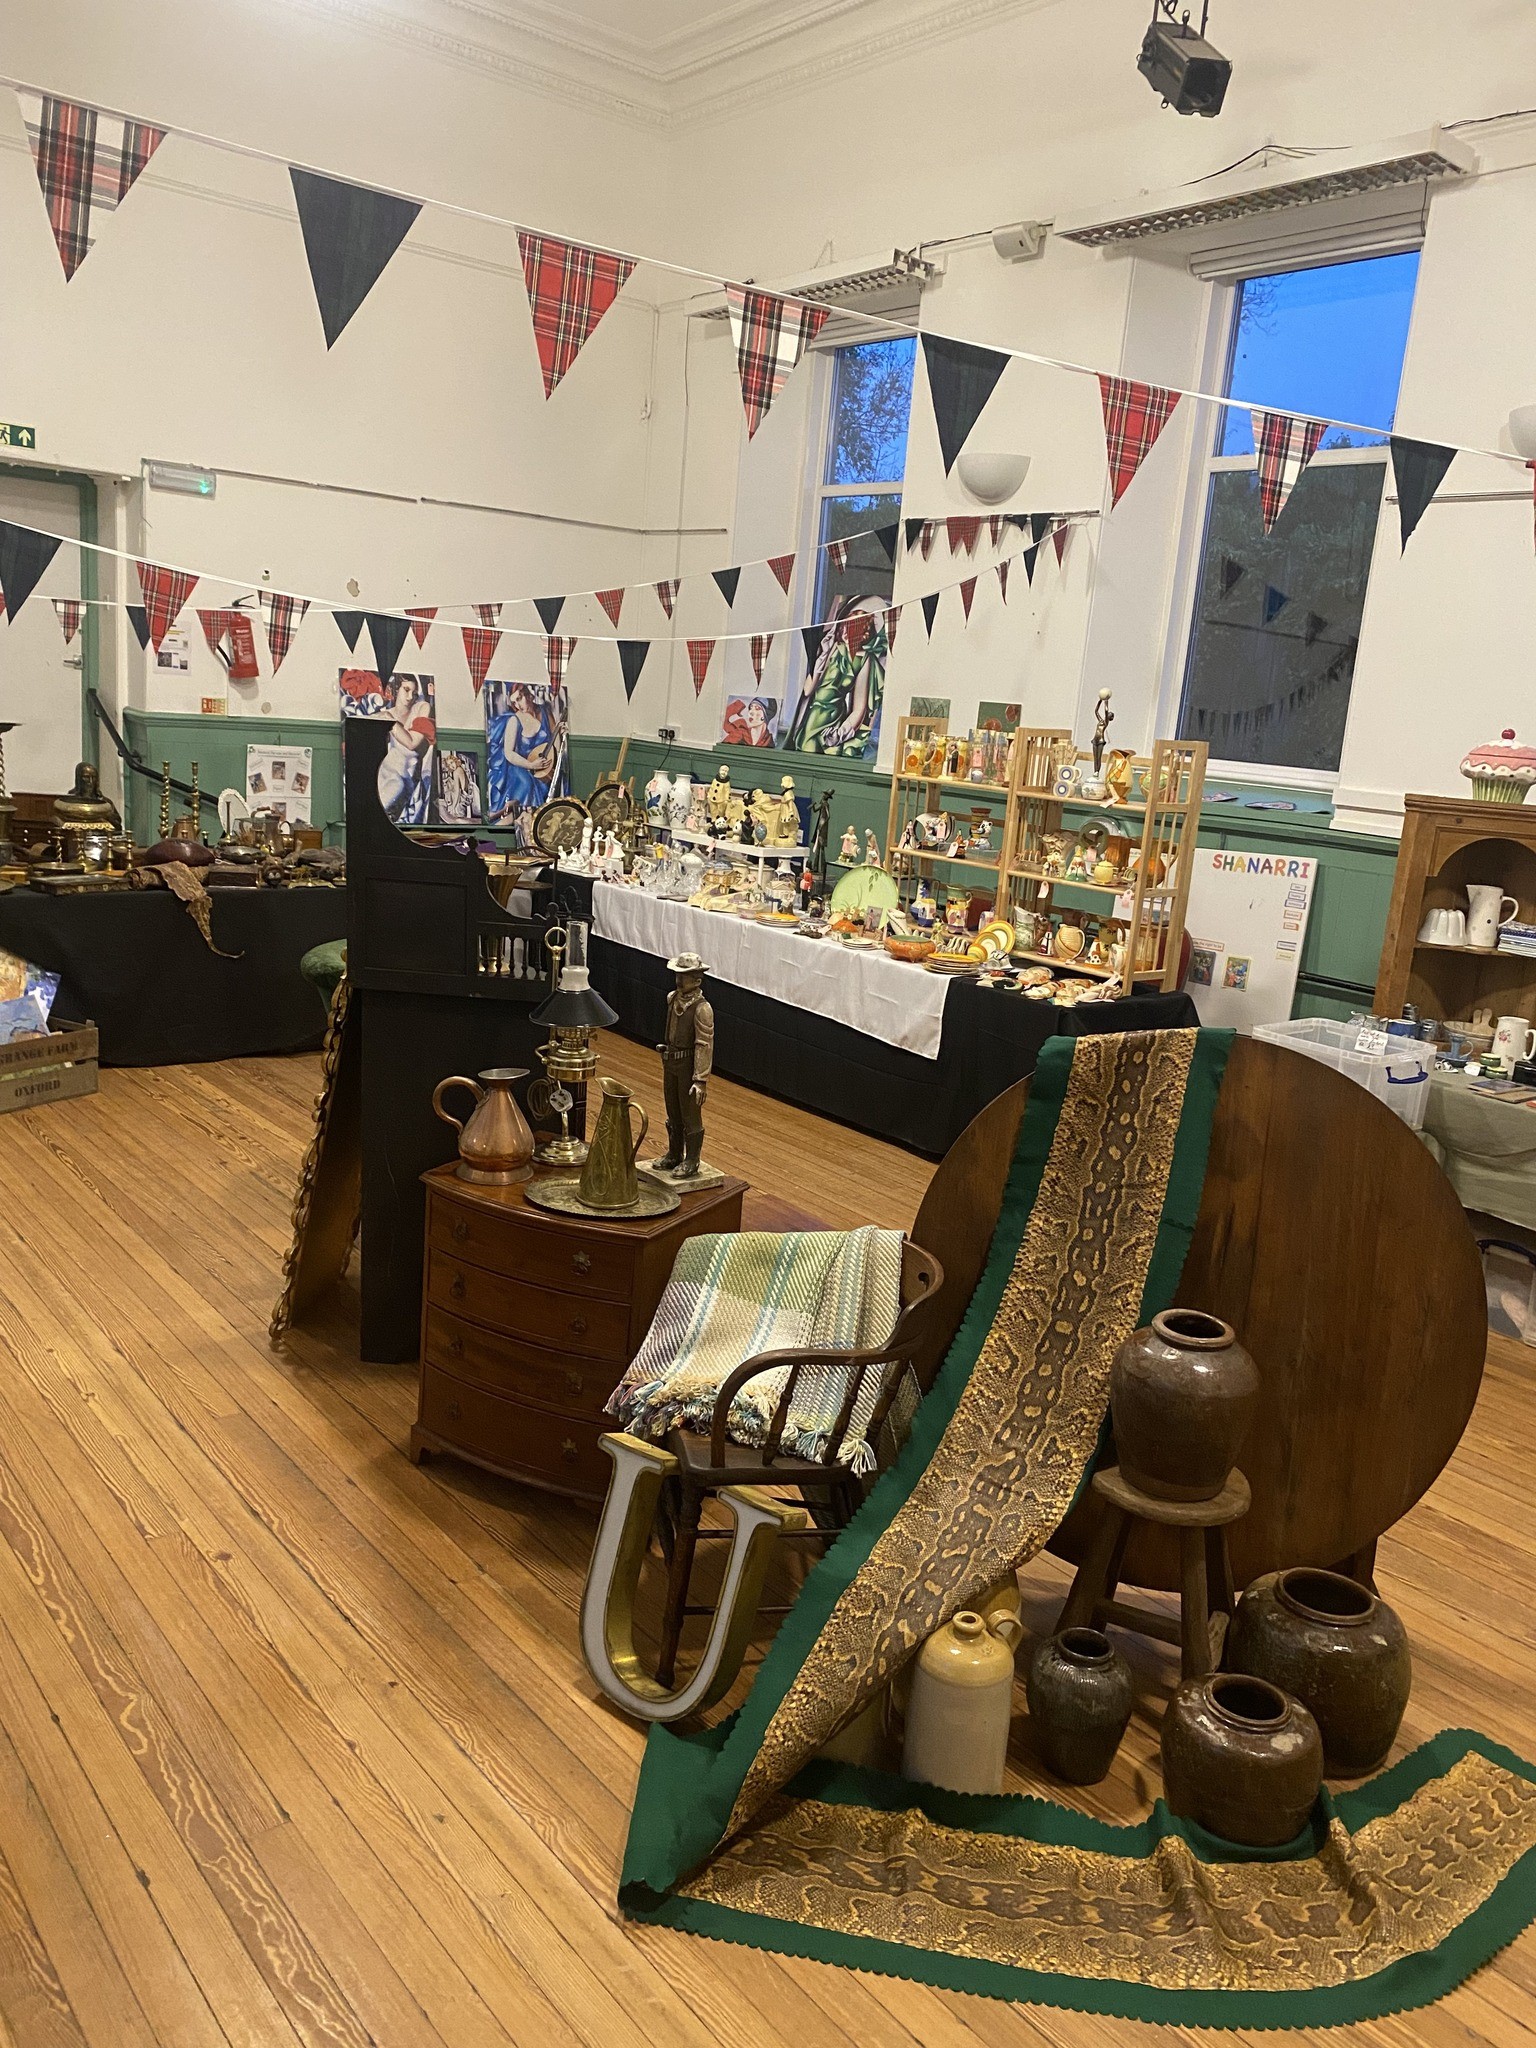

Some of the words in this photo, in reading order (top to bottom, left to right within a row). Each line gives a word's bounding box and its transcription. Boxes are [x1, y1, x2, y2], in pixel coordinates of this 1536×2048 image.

[1212, 853, 1310, 878] SHANARRI
[48, 1042, 78, 1055] FARM
[15, 1081, 61, 1096] OXFORD
